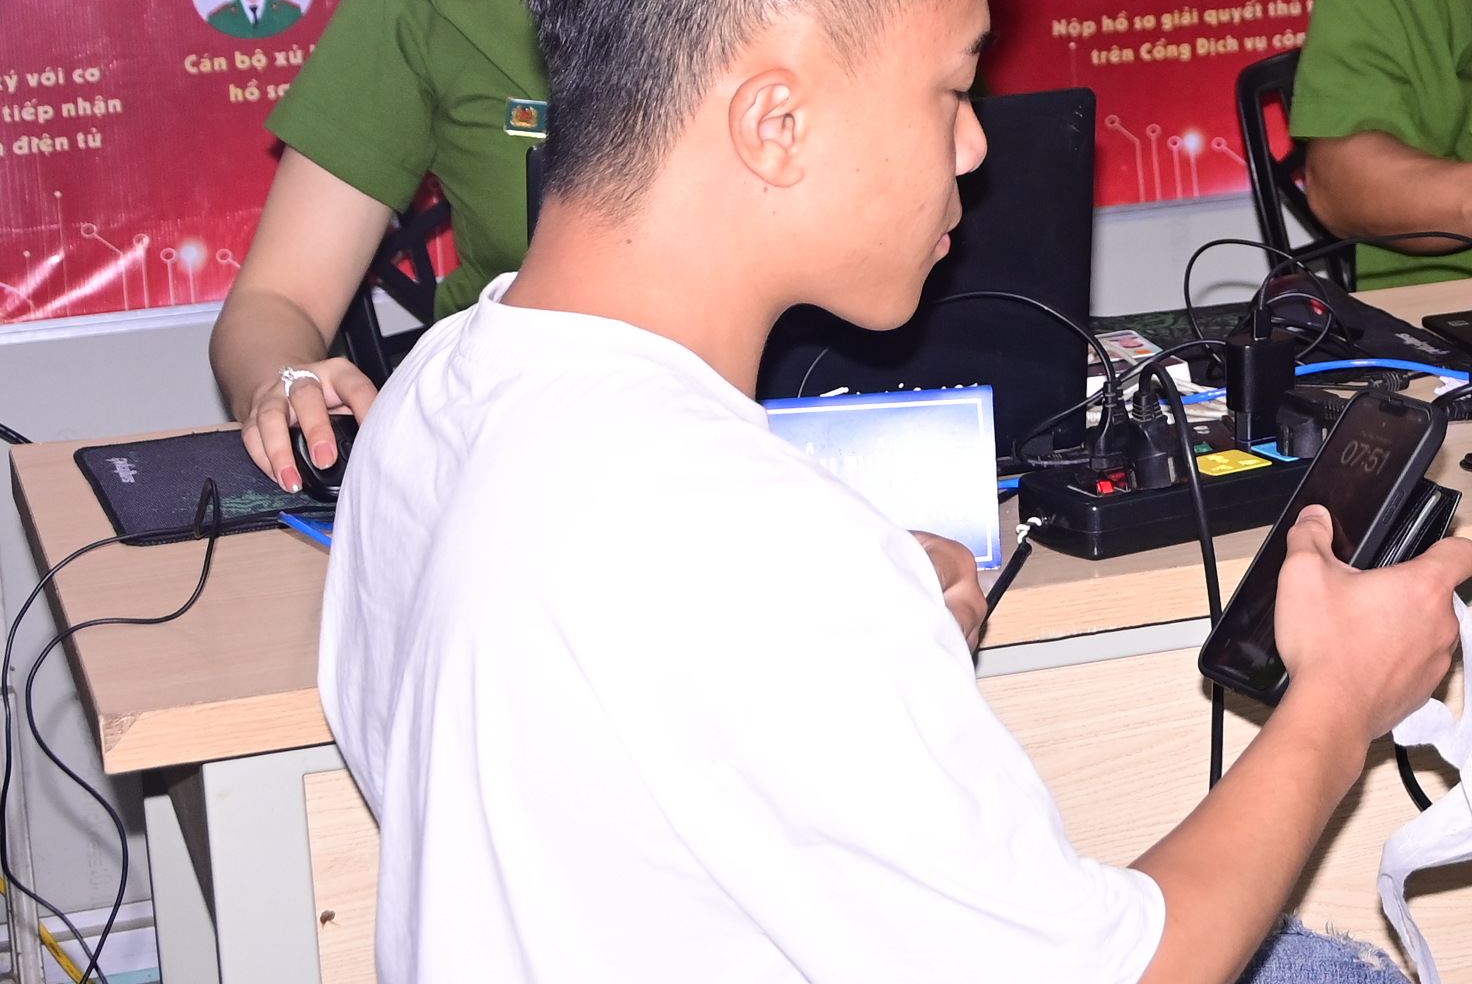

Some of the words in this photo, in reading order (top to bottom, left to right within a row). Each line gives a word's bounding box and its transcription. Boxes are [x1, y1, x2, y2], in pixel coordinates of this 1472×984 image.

[1052, 18, 1096, 37] Nộp
[1102, 11, 1128, 32] hồ
[184, 54, 228, 74] Cán
[235, 49, 267, 70] bộ
[1091, 45, 1134, 65] trên
[1140, 38, 1191, 61] Cổng
[1196, 35, 1239, 56] Dịch
[26, 67, 65, 87] với
[229, 79, 260, 102] hồ
[2, 99, 54, 123] tiếp
[62, 95, 122, 117] nhận
[12, 133, 69, 155] điện
[77, 128, 102, 149] tử
